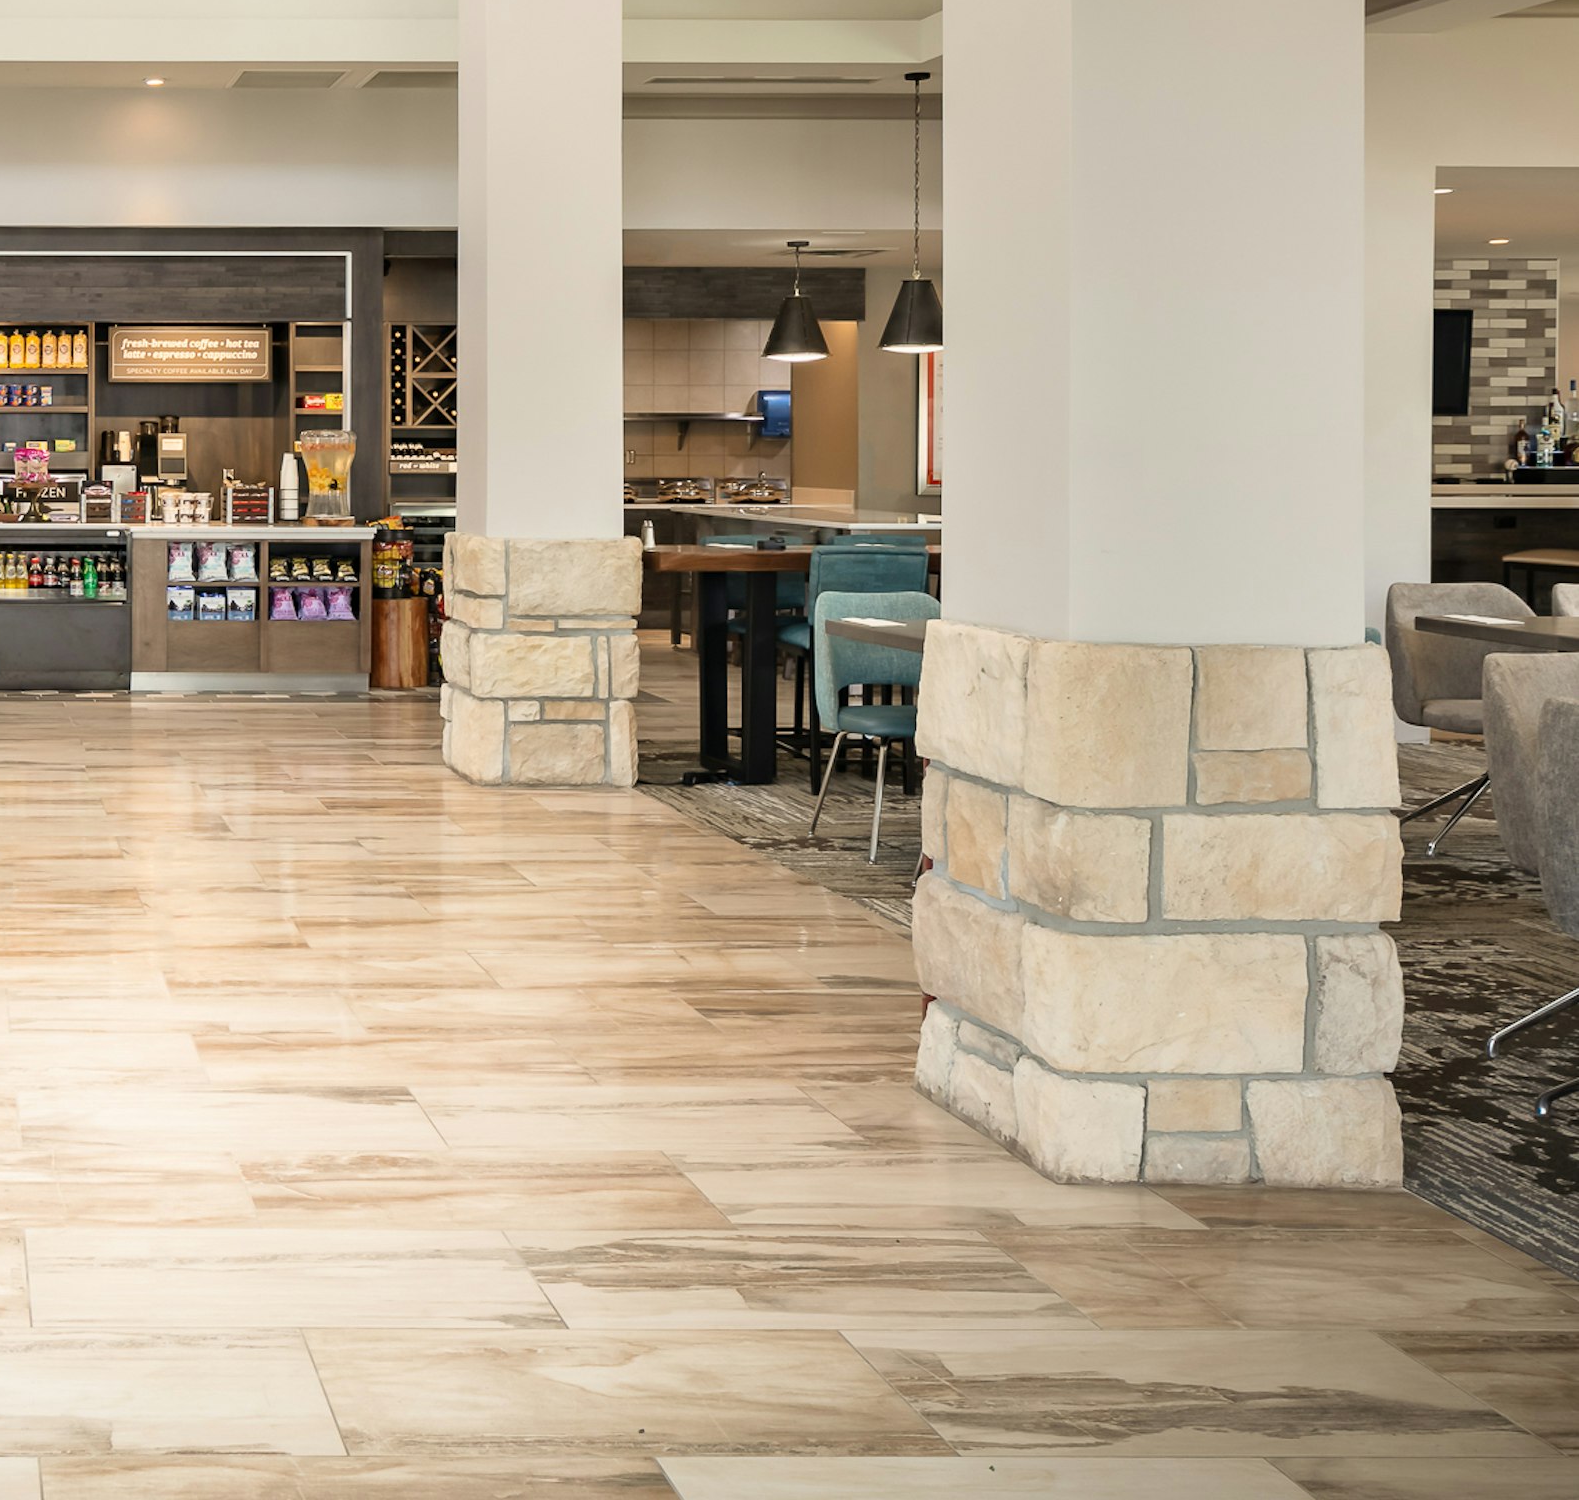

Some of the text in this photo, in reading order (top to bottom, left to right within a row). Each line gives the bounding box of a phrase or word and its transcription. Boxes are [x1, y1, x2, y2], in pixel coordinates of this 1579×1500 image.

[121, 338, 260, 350] fresh-brewed coffee hot tea
[123, 349, 258, 361] latte espresso cappuccino
[15, 486, 67, 498] FZEN
